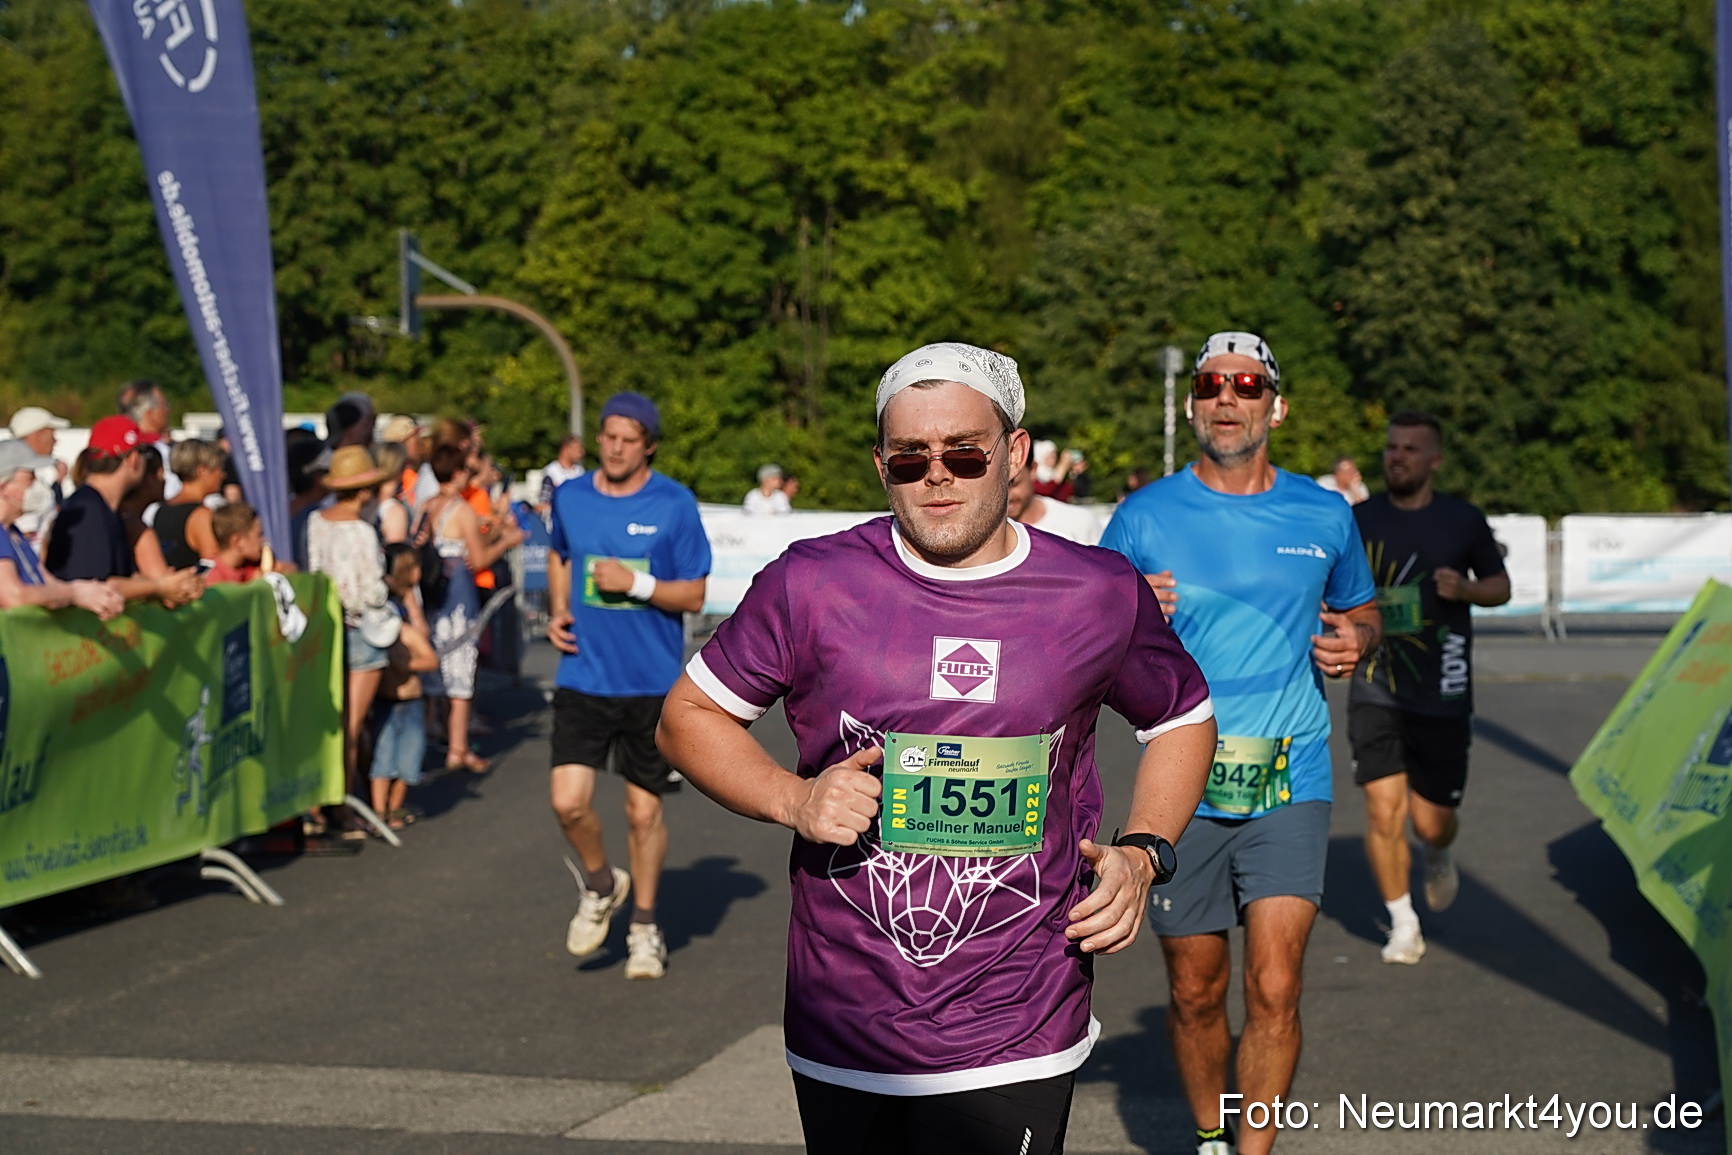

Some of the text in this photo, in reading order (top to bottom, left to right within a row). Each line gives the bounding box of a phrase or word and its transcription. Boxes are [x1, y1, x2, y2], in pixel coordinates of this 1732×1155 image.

[937, 662, 993, 676] FUCHS
[1440, 632, 1468, 696] now
[928, 758, 980, 768] Firmenlauf
[892, 788, 907, 829] RUN
[913, 776, 1018, 818] 1551
[1024, 783, 1040, 837] 2022
[906, 818, 1025, 835] Soellner Manuel
